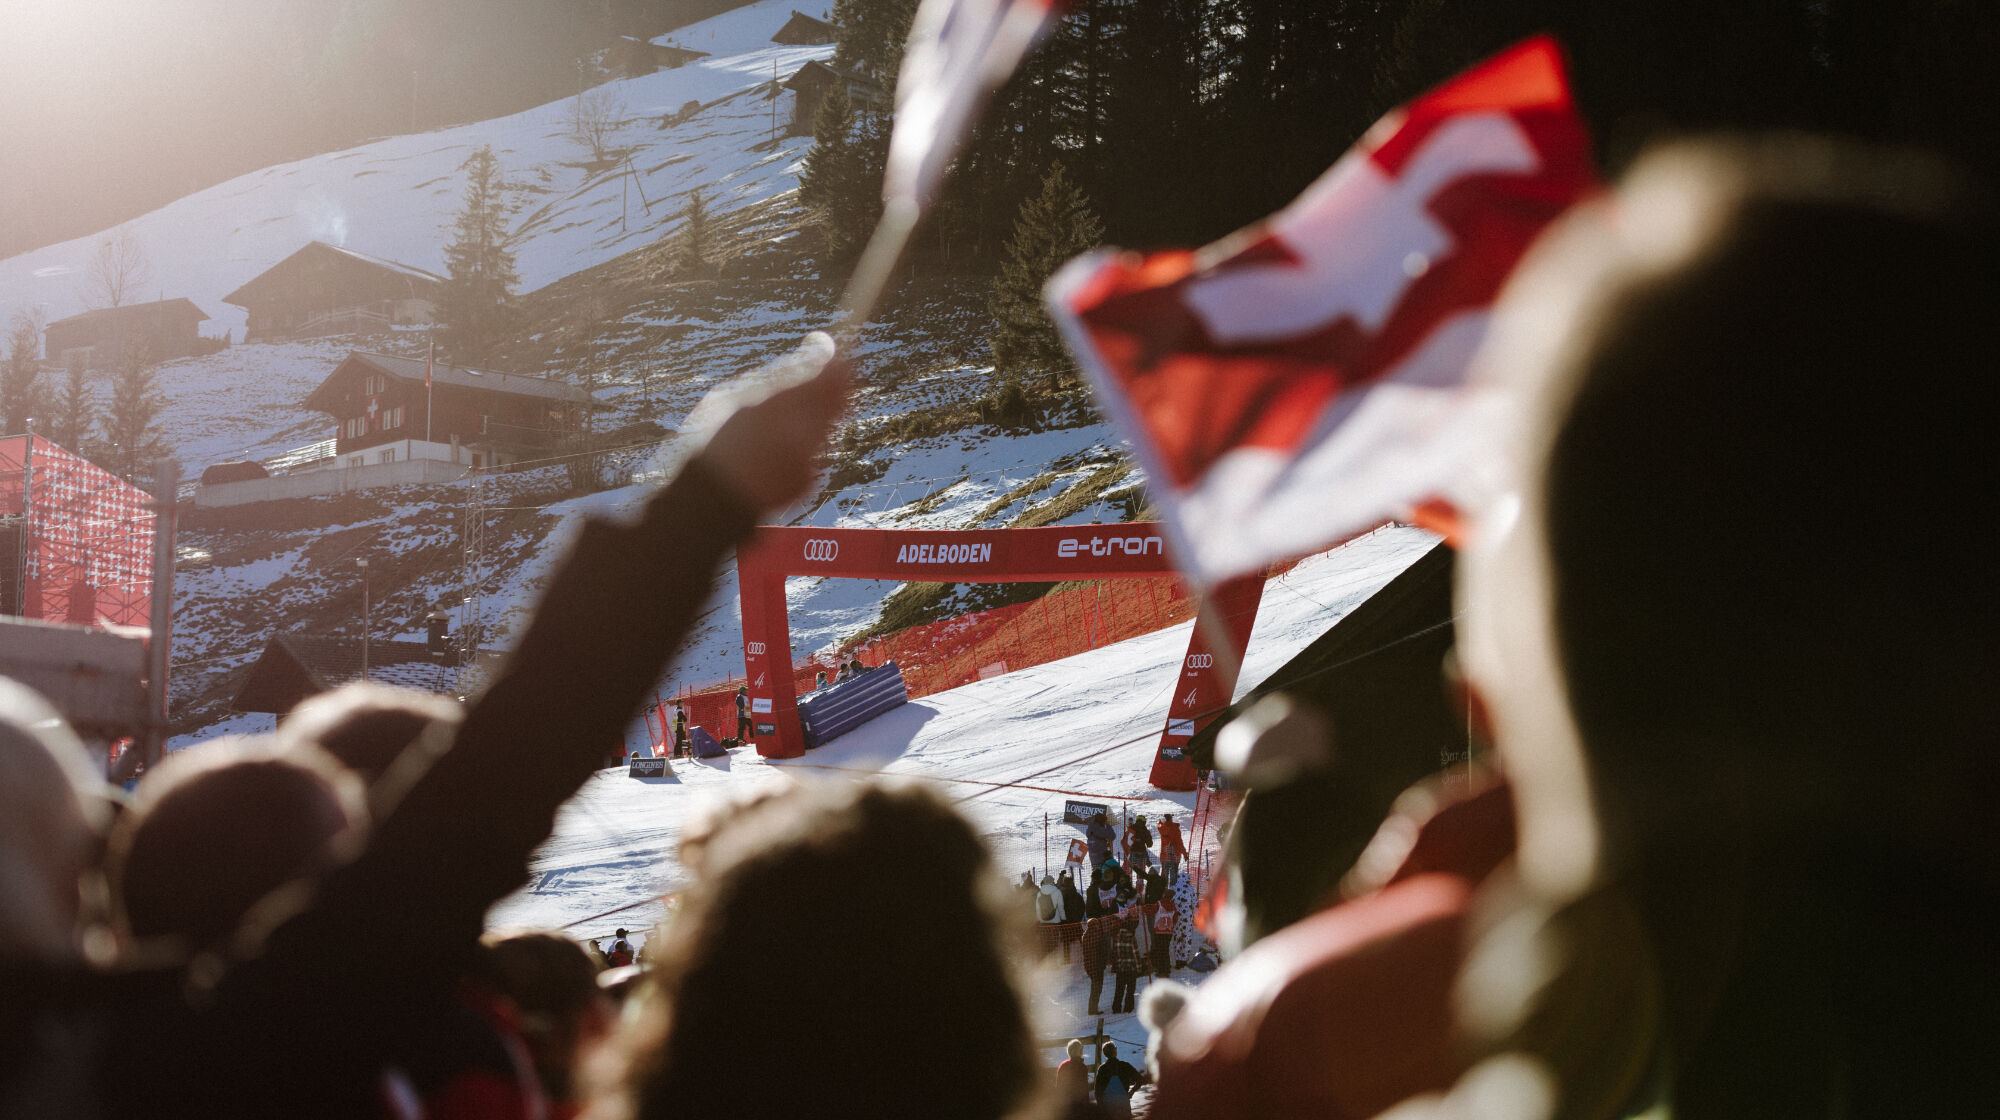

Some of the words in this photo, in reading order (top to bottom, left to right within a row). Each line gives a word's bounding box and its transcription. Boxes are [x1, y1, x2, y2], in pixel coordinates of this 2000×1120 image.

[896, 543, 992, 564] ADELBODEN
[1057, 536, 1163, 558] e-tron
[632, 761, 664, 769] LONGINES
[1066, 804, 1104, 816] LONGINES
